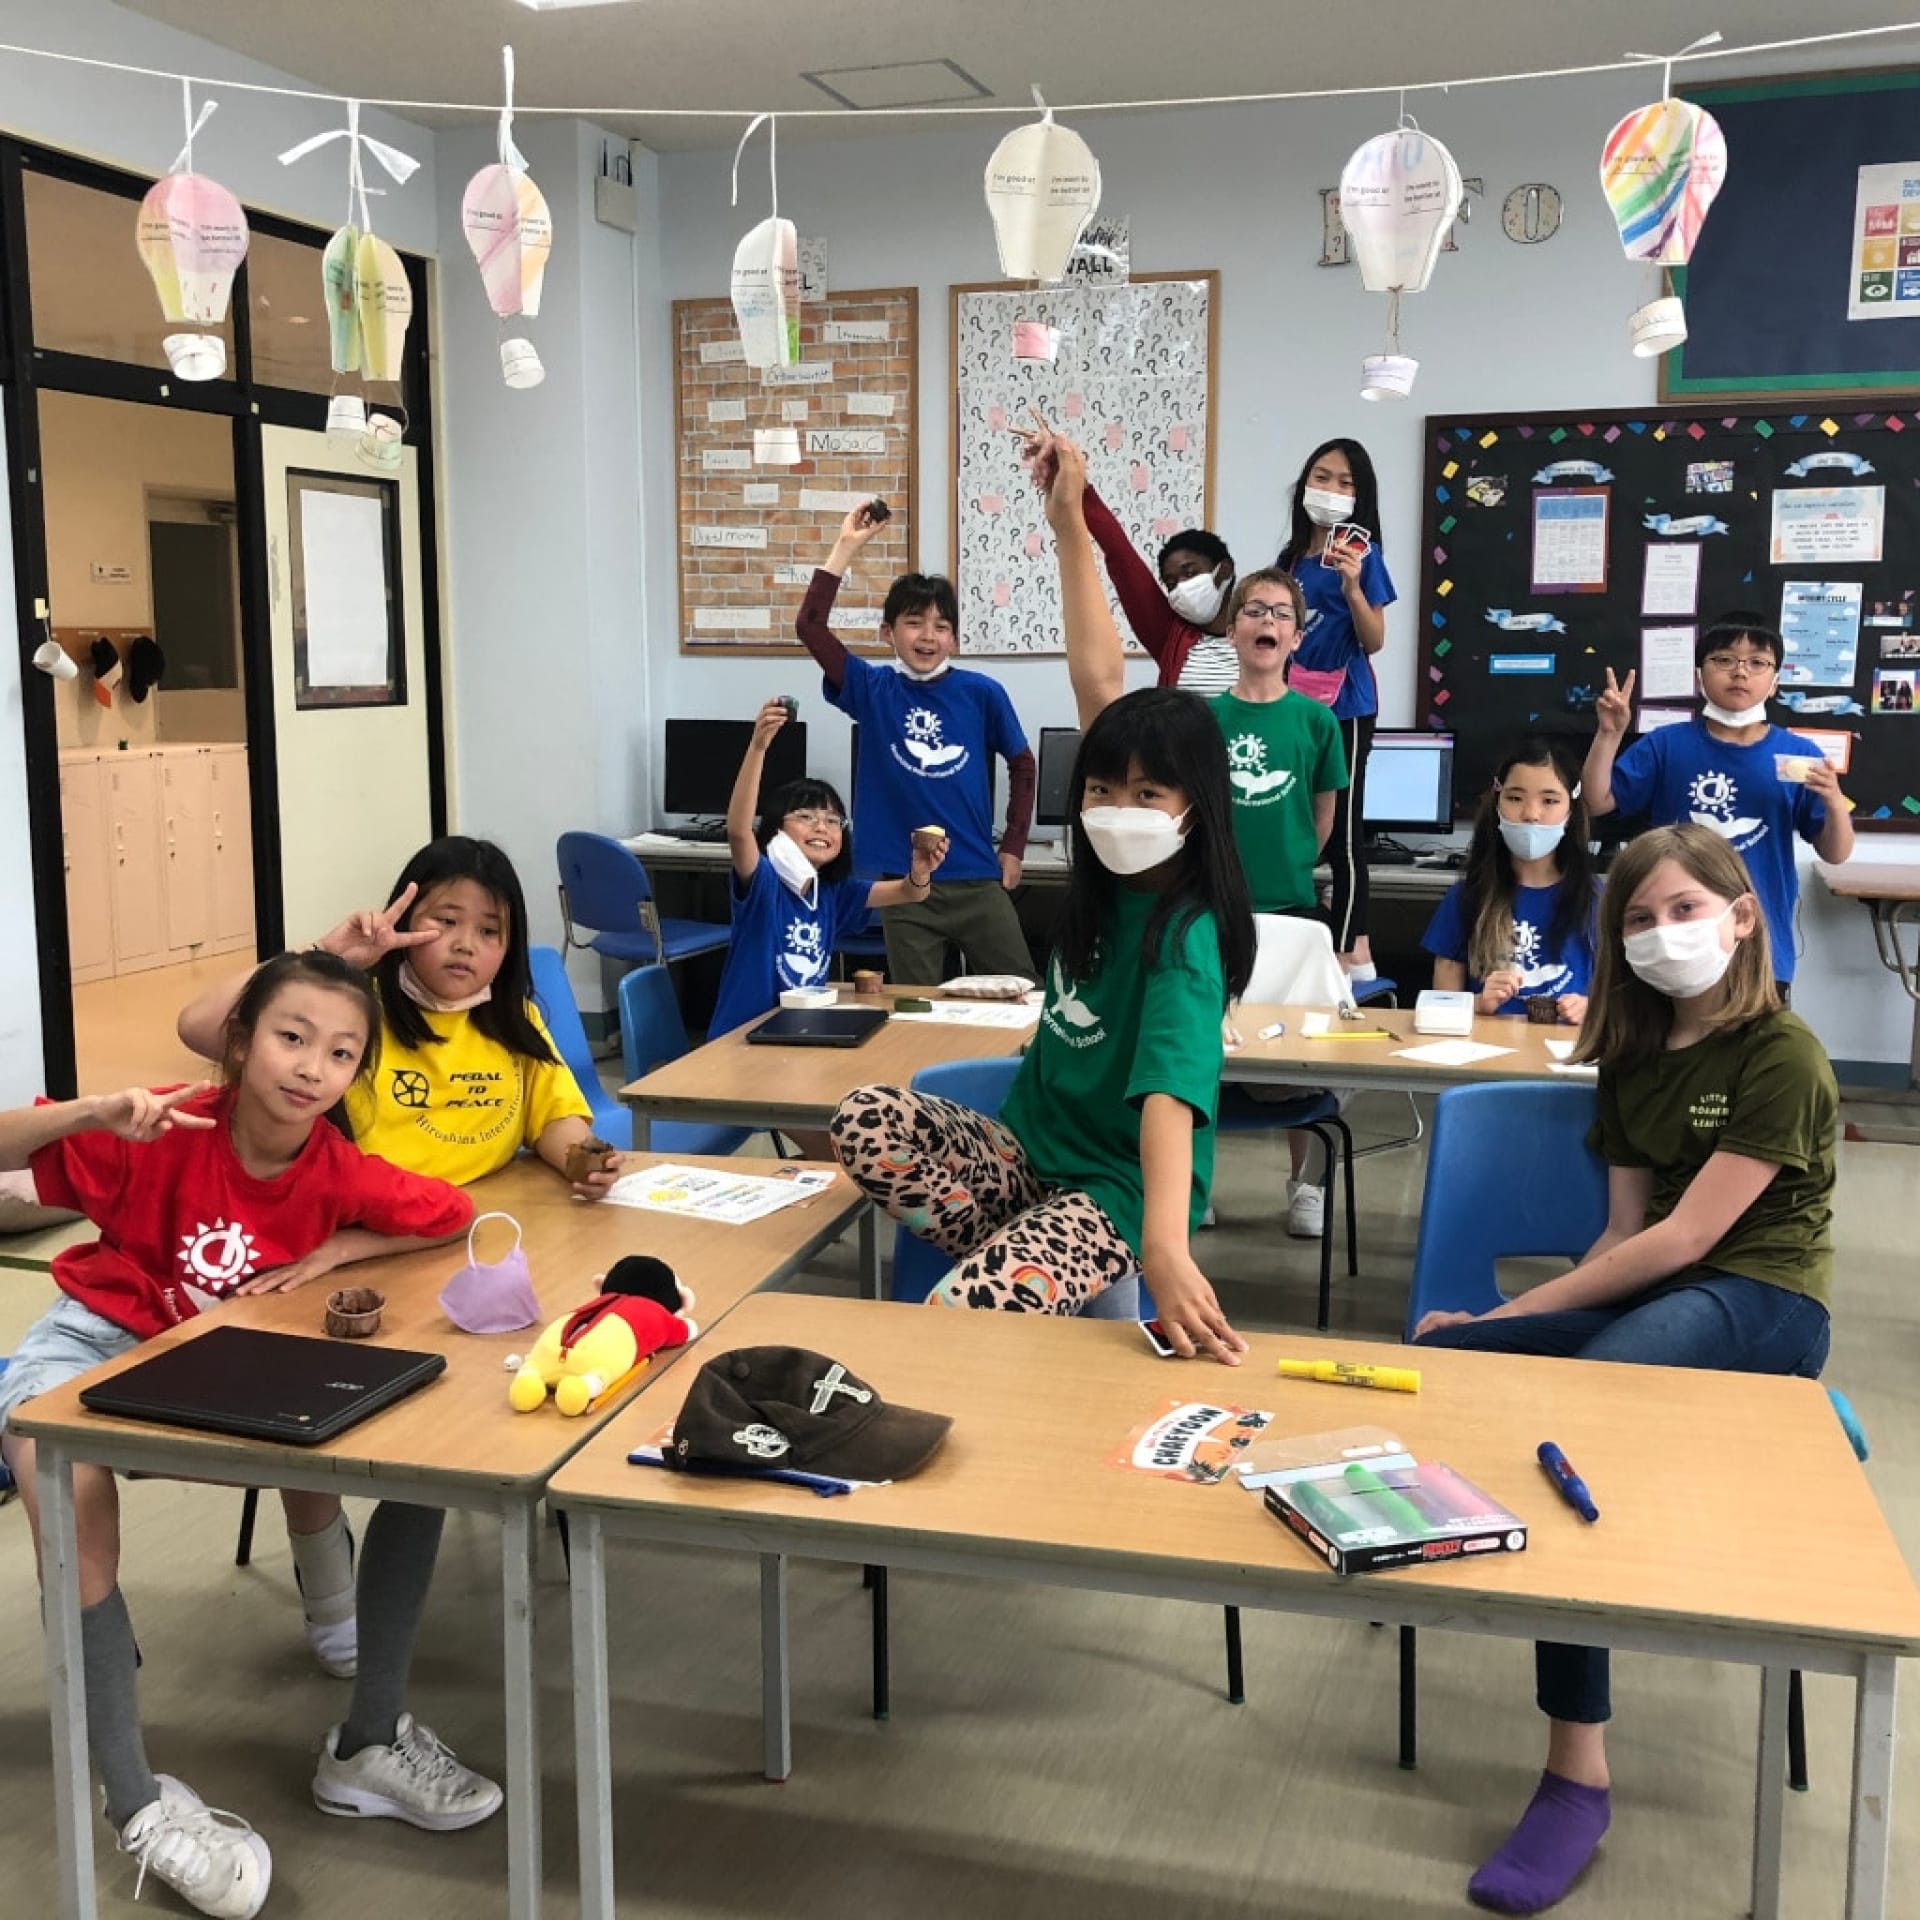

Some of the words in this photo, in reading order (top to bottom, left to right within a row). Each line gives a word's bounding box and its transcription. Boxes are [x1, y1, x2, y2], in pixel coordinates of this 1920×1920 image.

[449, 1071, 503, 1082] PEDAL
[467, 1085, 488, 1095] TO
[445, 1098, 505, 1108] PEACE
[415, 1112, 477, 1145] Hiroshima
[1152, 1407, 1223, 1466] CHAEYOON
